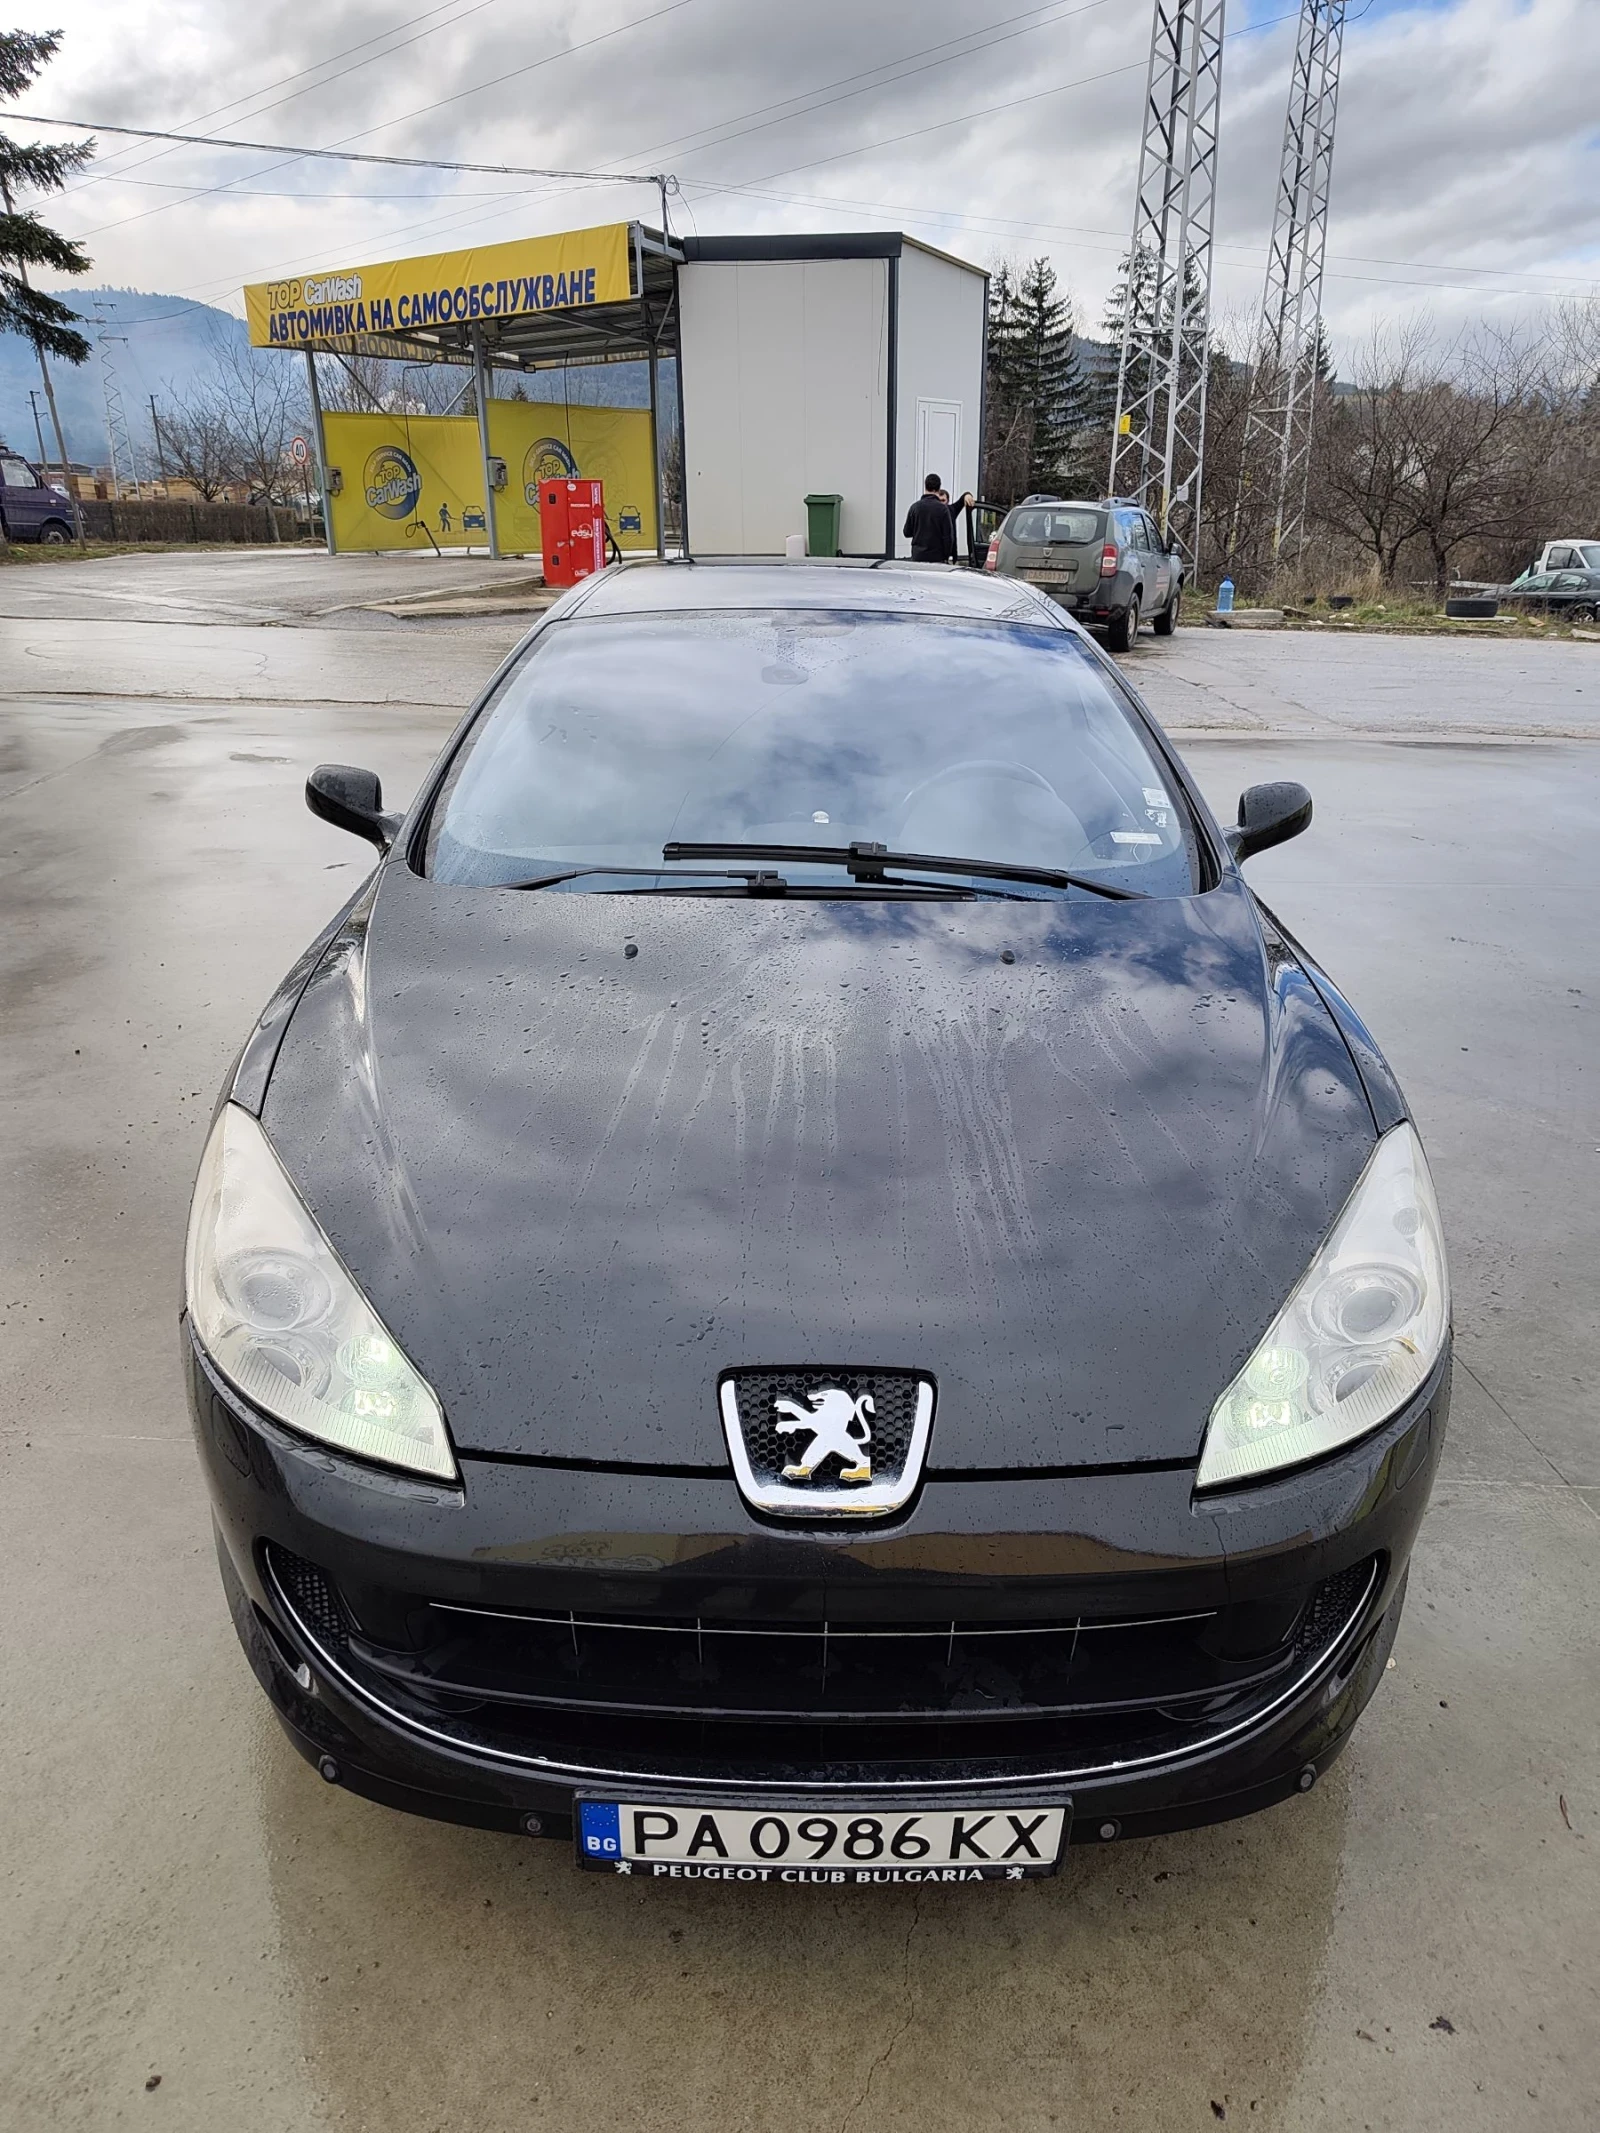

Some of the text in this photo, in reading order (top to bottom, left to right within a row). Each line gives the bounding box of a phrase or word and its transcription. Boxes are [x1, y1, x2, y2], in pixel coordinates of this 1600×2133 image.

[267, 273, 363, 311] TOP CarWash
[269, 268, 596, 343] АВТОМИВКА НА САМООБСЛУЖВАНЕ
[295, 443, 305, 458] 40
[379, 465, 400, 483] TOP
[539, 459, 561, 479] TOP
[366, 472, 422, 507] CarWash
[587, 1836, 617, 1851] BG
[633, 1810, 1049, 1860] PA 0986 KX
[653, 1864, 984, 1883] PEUGEOT CLUB BULGARIA
